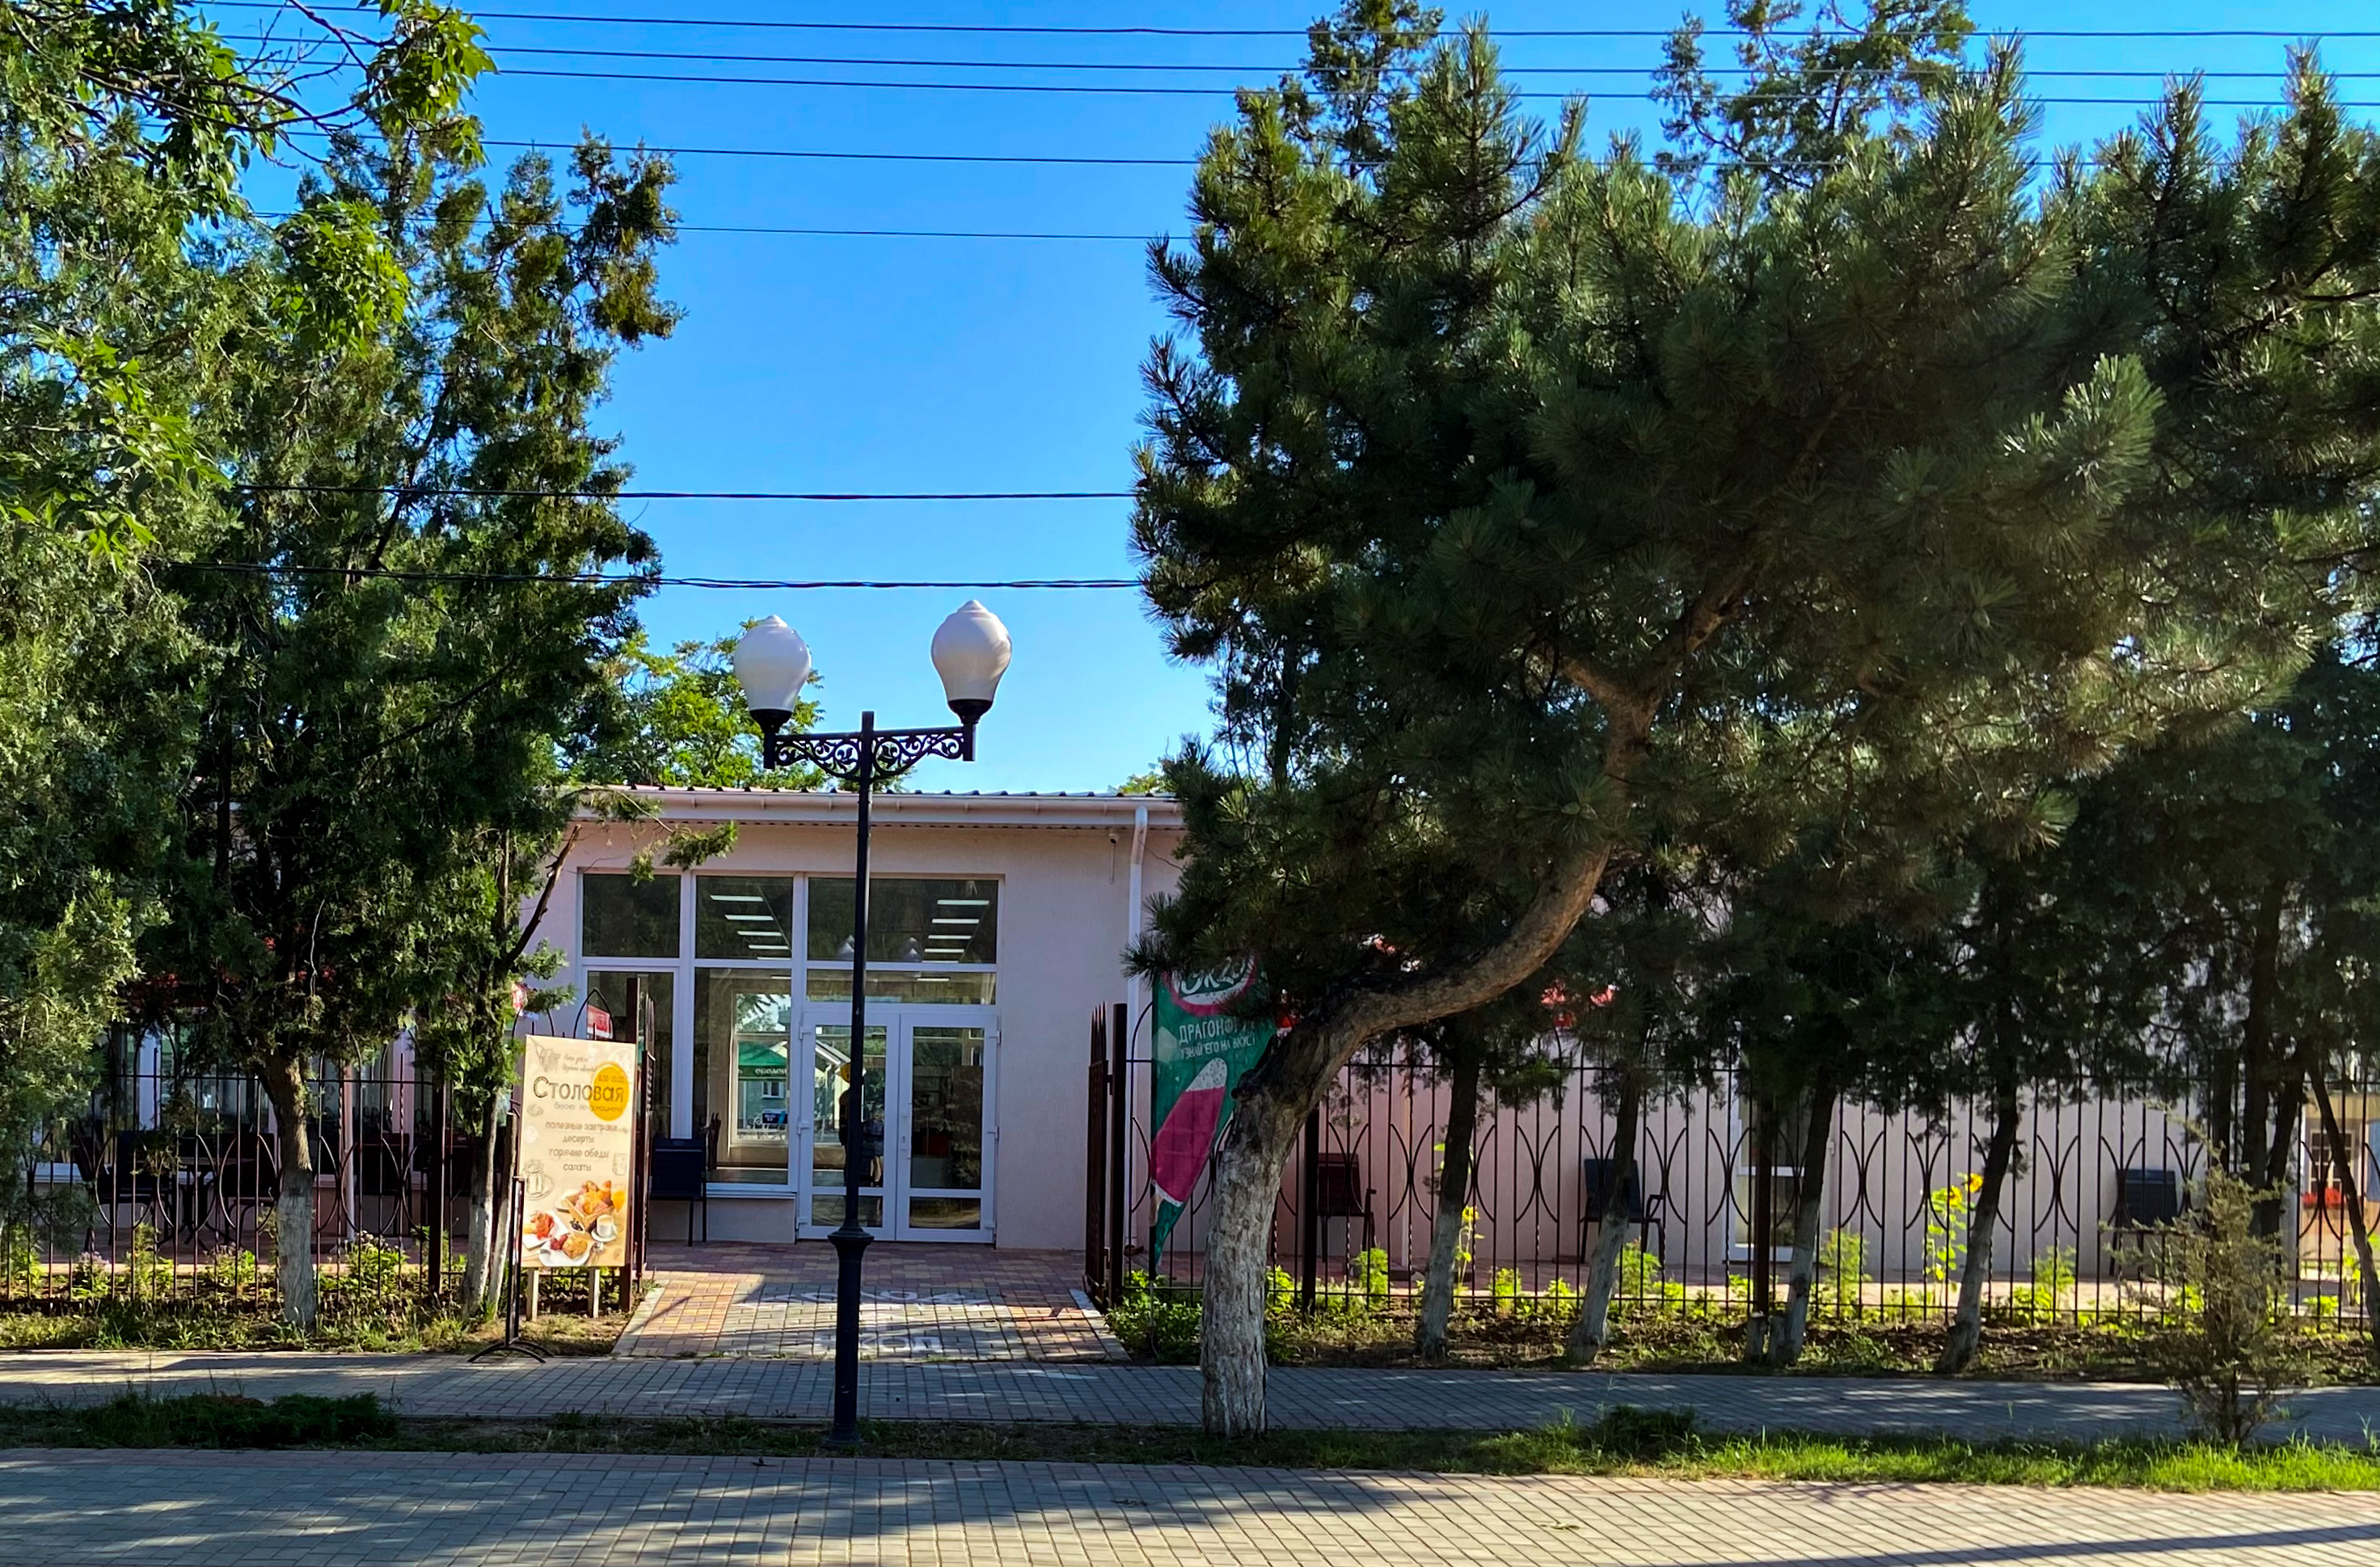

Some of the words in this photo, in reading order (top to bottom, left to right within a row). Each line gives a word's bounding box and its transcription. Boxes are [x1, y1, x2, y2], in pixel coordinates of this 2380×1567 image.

[1179, 1019, 1255, 1045] ДРАГОНФ
[1205, 1042, 1219, 1054] ЕГО
[1221, 1039, 1230, 1051] НА
[533, 1076, 624, 1103] Столовая
[546, 1121, 583, 1130] полезные
[563, 1135, 595, 1144] десерты
[550, 1148, 582, 1159] горячие
[584, 1148, 610, 1159] обеды
[563, 1163, 592, 1172] салаты
